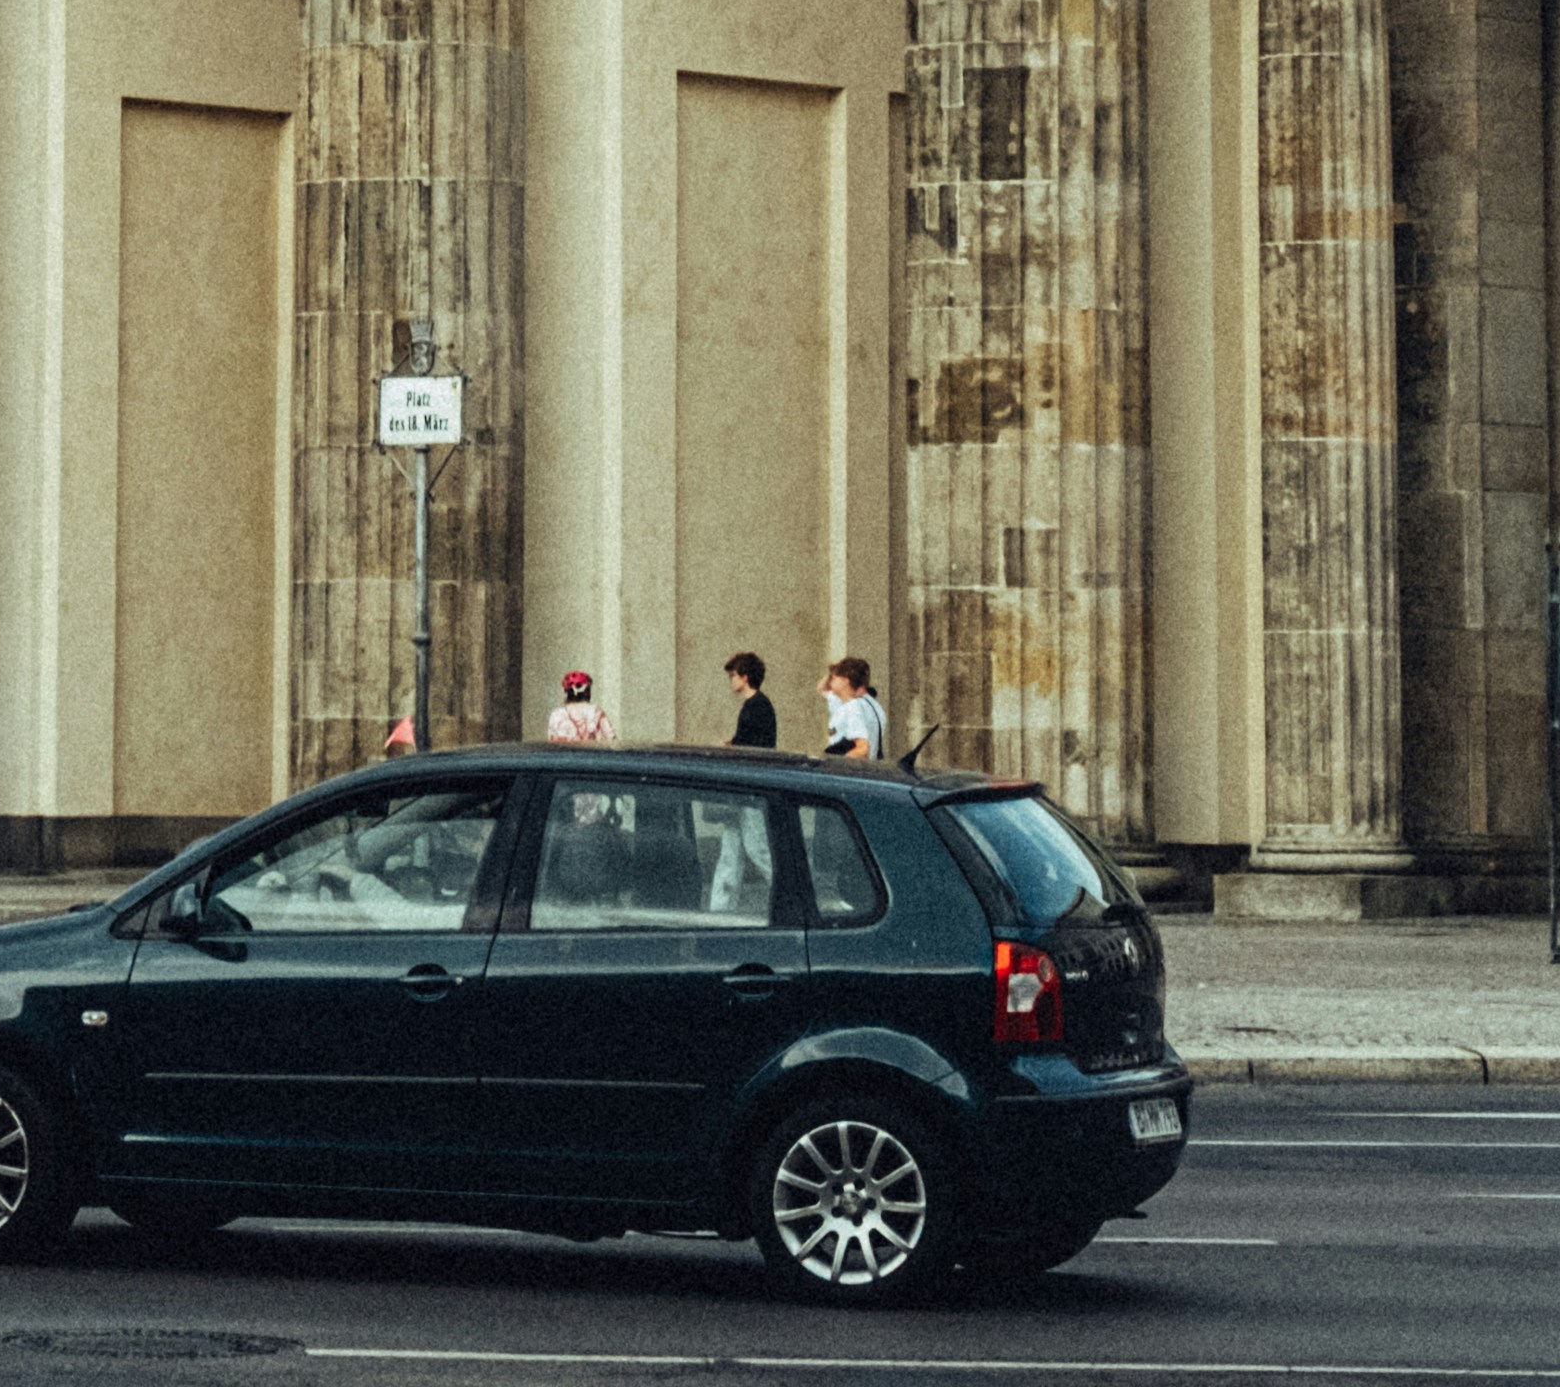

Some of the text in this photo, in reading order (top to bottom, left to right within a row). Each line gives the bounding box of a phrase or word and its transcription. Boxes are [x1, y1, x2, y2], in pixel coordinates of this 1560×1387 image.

[406, 391, 431, 407] Platz
[389, 415, 405, 432] des
[424, 413, 449, 431] März
